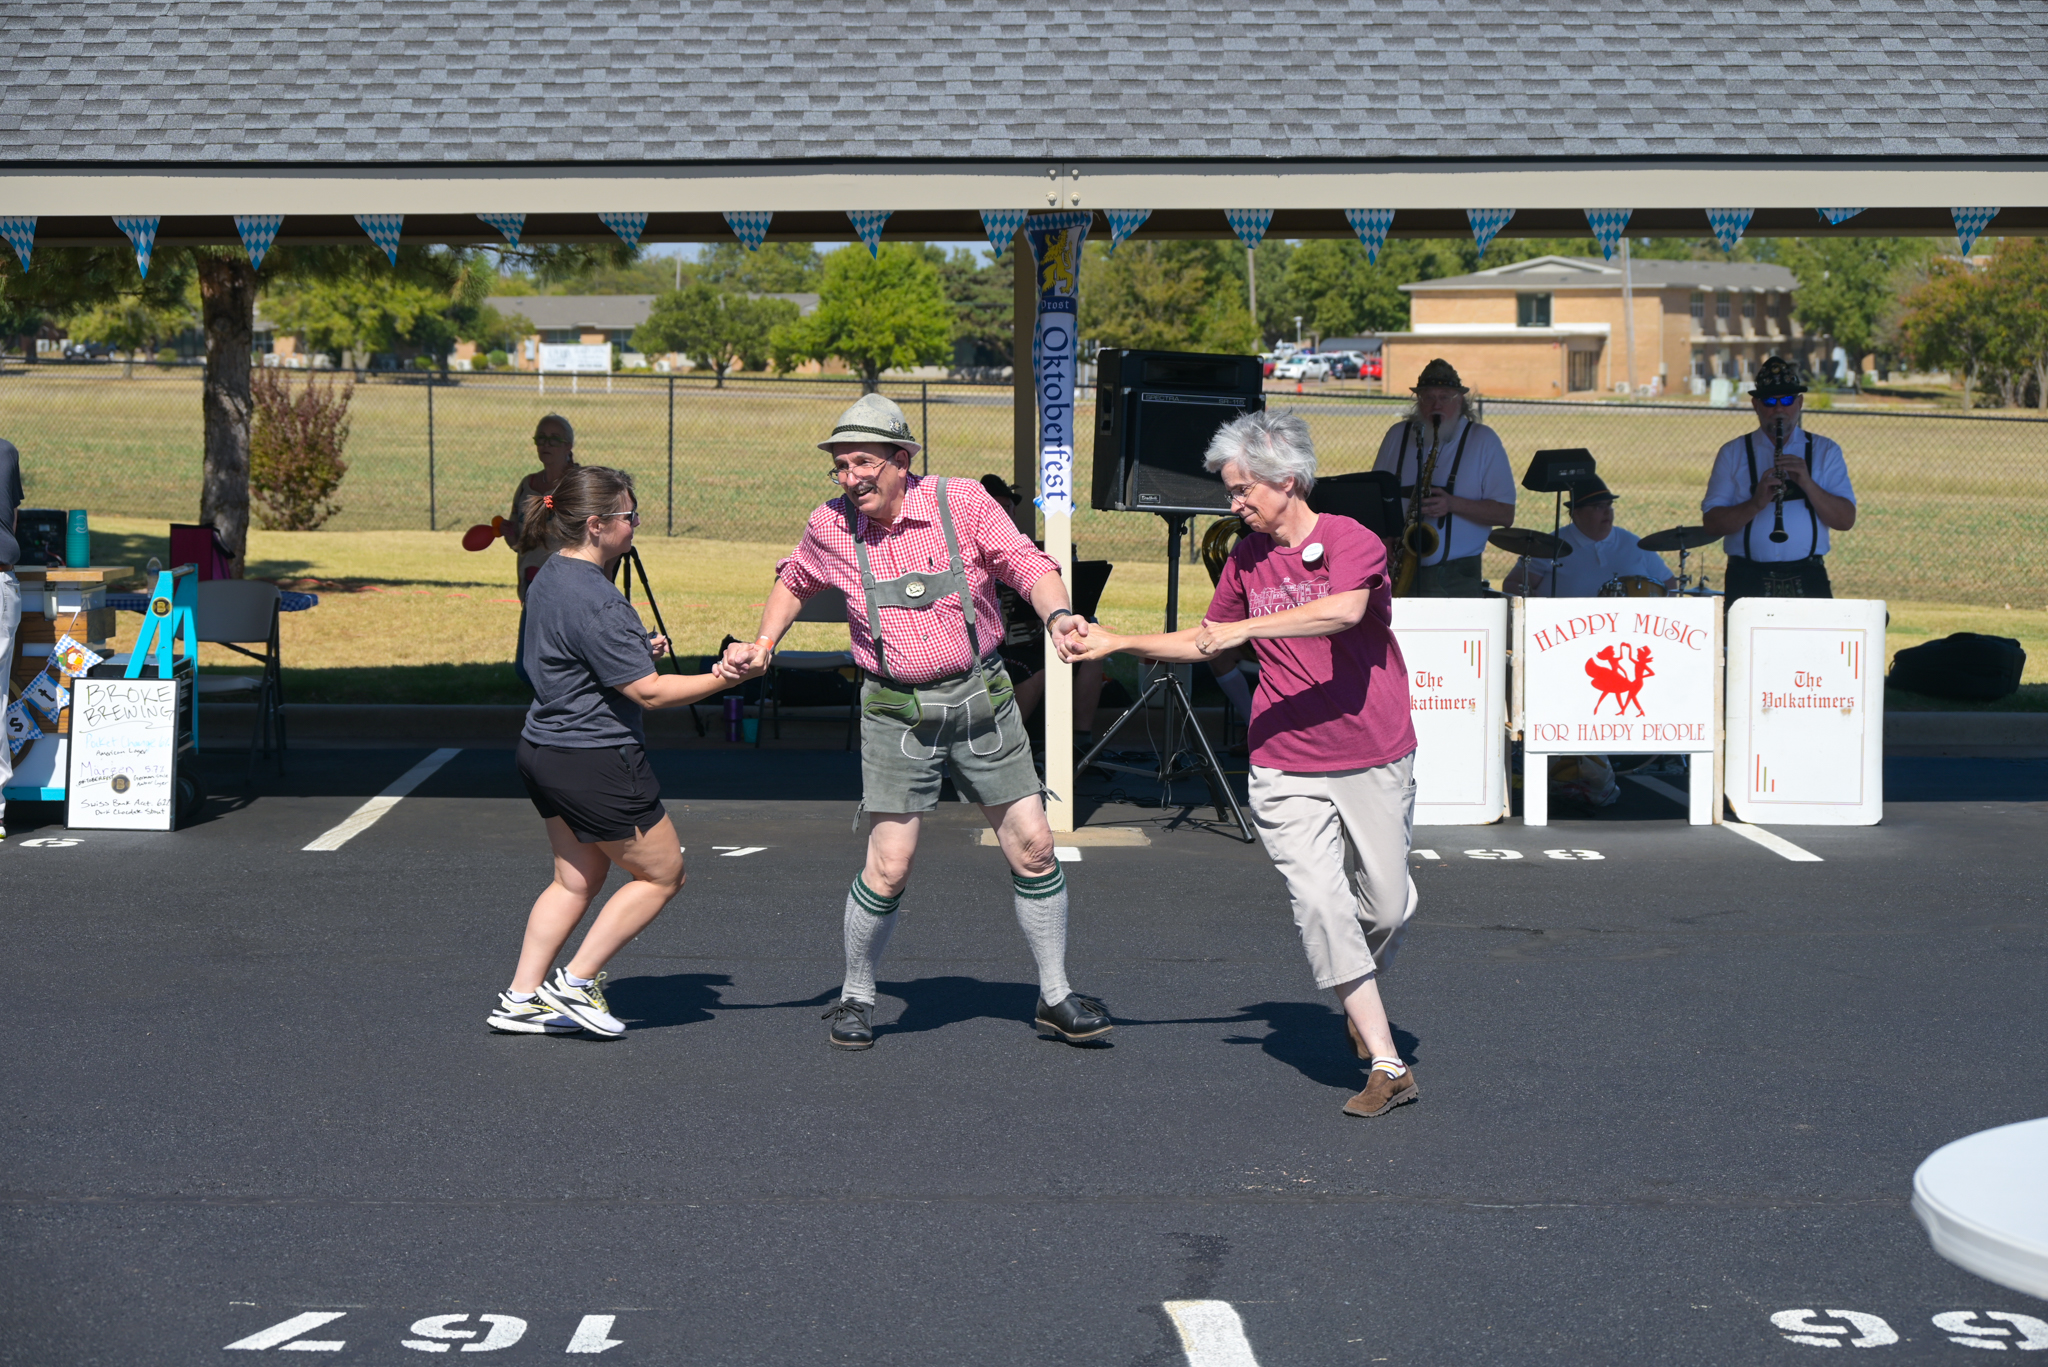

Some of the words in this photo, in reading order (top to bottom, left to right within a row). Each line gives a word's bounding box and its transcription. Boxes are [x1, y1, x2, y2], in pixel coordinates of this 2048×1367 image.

[1145, 394, 1180, 402] SPECTRA
[1042, 326, 1072, 502] Oktoberfest
[1533, 612, 1620, 652] HAPPY
[1633, 613, 1709, 650] MUSIC
[1415, 671, 1444, 692] The
[1794, 670, 1823, 692] The
[86, 684, 173, 707] BROKE
[1410, 694, 1476, 711] katimers
[1762, 691, 1855, 708] Polkatimers
[83, 704, 174, 727] BREWING
[1533, 723, 1570, 741] FOR
[1578, 723, 1634, 741] HAPPY
[1642, 723, 1706, 741] PEOPLE
[80, 799, 110, 809] Swiss
[1410, 848, 1606, 861] 198
[221, 1310, 625, 1354] 167
